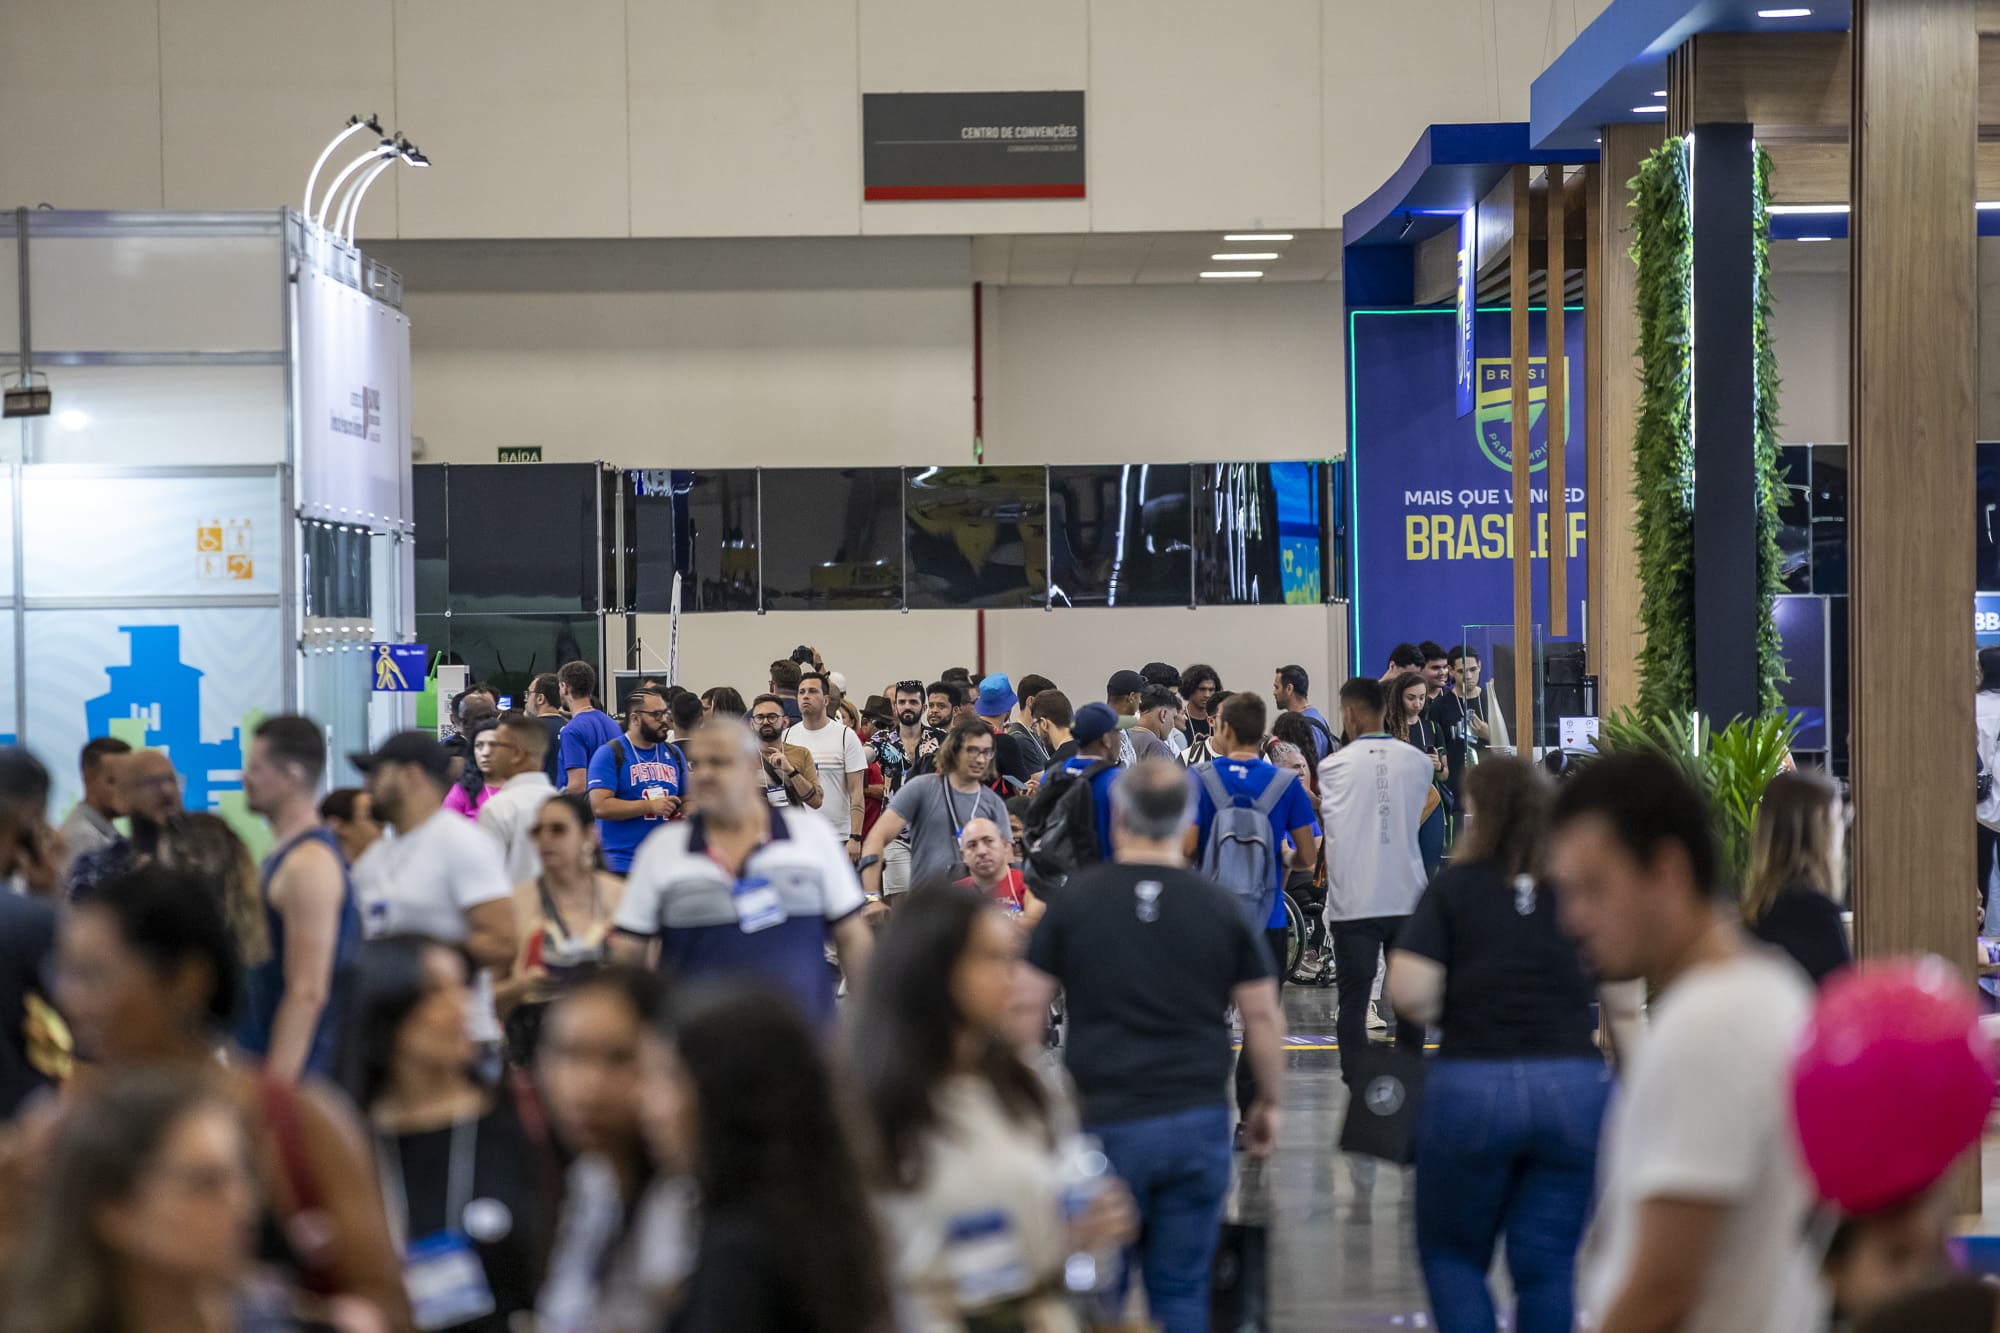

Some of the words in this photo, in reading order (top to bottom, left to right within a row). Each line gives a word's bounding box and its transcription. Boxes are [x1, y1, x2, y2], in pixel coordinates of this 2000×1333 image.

[962, 126, 999, 139] CENTRO
[1001, 126, 1014, 138] DE
[1015, 123, 1078, 140] CONVENÇÕES
[1486, 368, 1546, 381] BRSI
[500, 449, 540, 463] SAÍDA
[1405, 490, 1453, 506] MAIS
[1458, 489, 1499, 508] QUE
[629, 762, 679, 788] PISTONS
